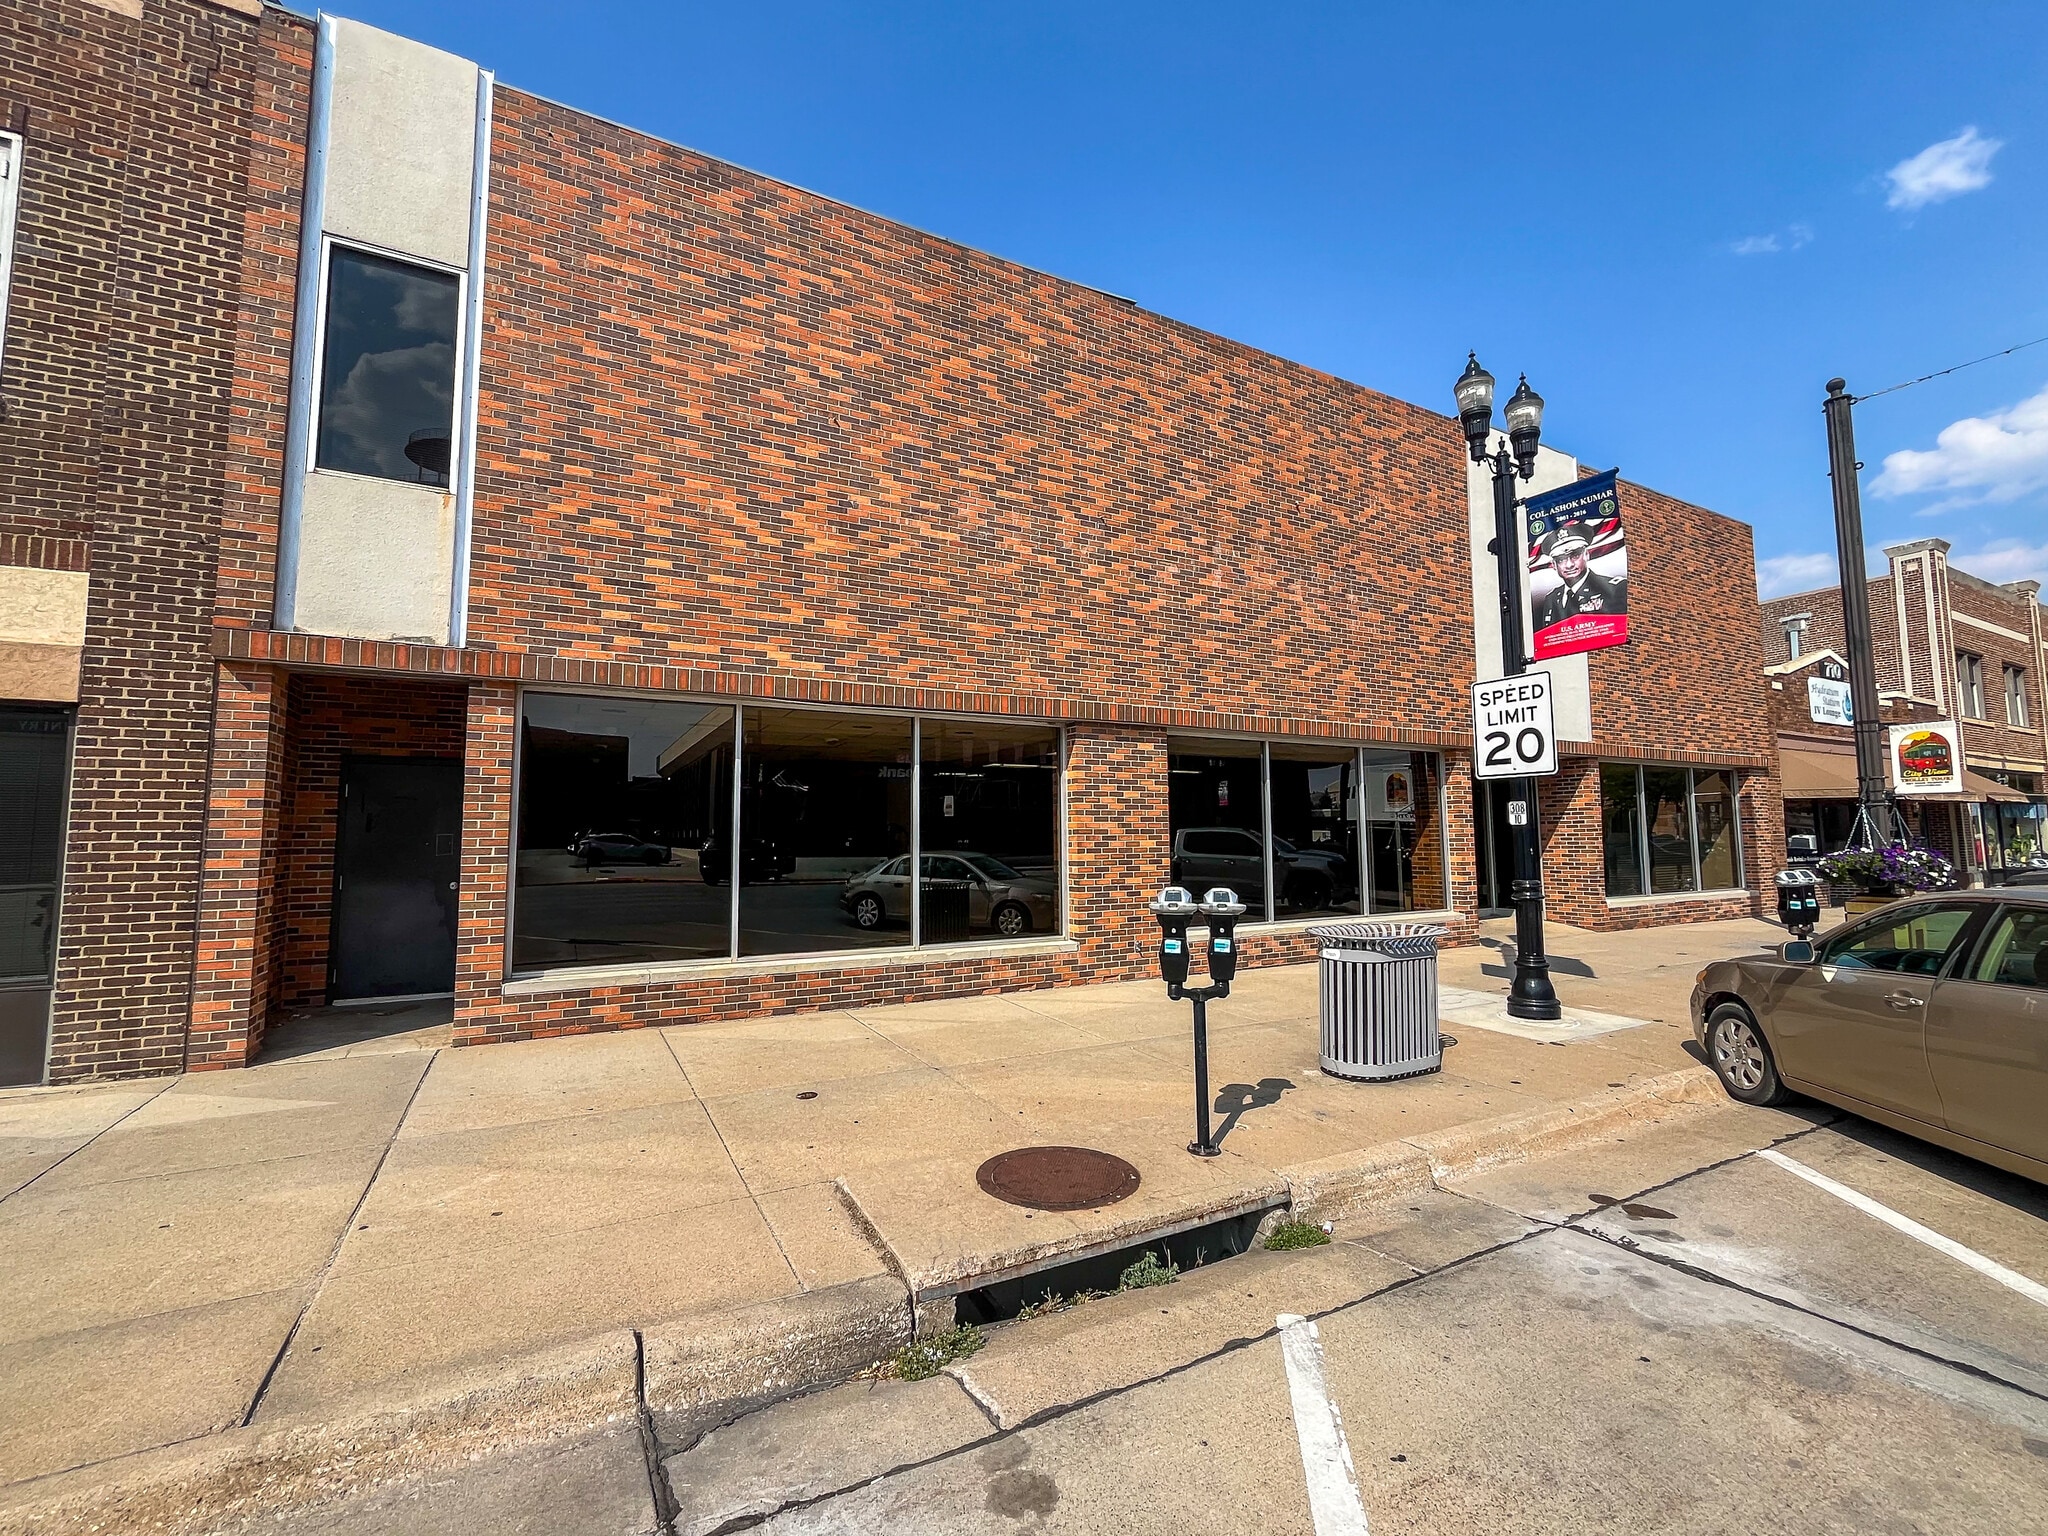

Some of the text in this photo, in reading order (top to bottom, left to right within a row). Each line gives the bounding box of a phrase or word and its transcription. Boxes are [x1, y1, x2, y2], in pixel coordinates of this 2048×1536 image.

[1529, 489, 1614, 521] COL. ASHOK KUMAR
[1573, 509, 1587, 519] 2016
[1560, 625, 1574, 633] U.S.
[1574, 621, 1597, 631] ARMY
[1480, 684, 1544, 707] SPEED
[1487, 705, 1538, 727] LIMIT
[1814, 705, 1822, 715] IV
[1484, 727, 1545, 767] 20
[1903, 767, 1949, 777] City View
[1510, 803, 1525, 814] 308
